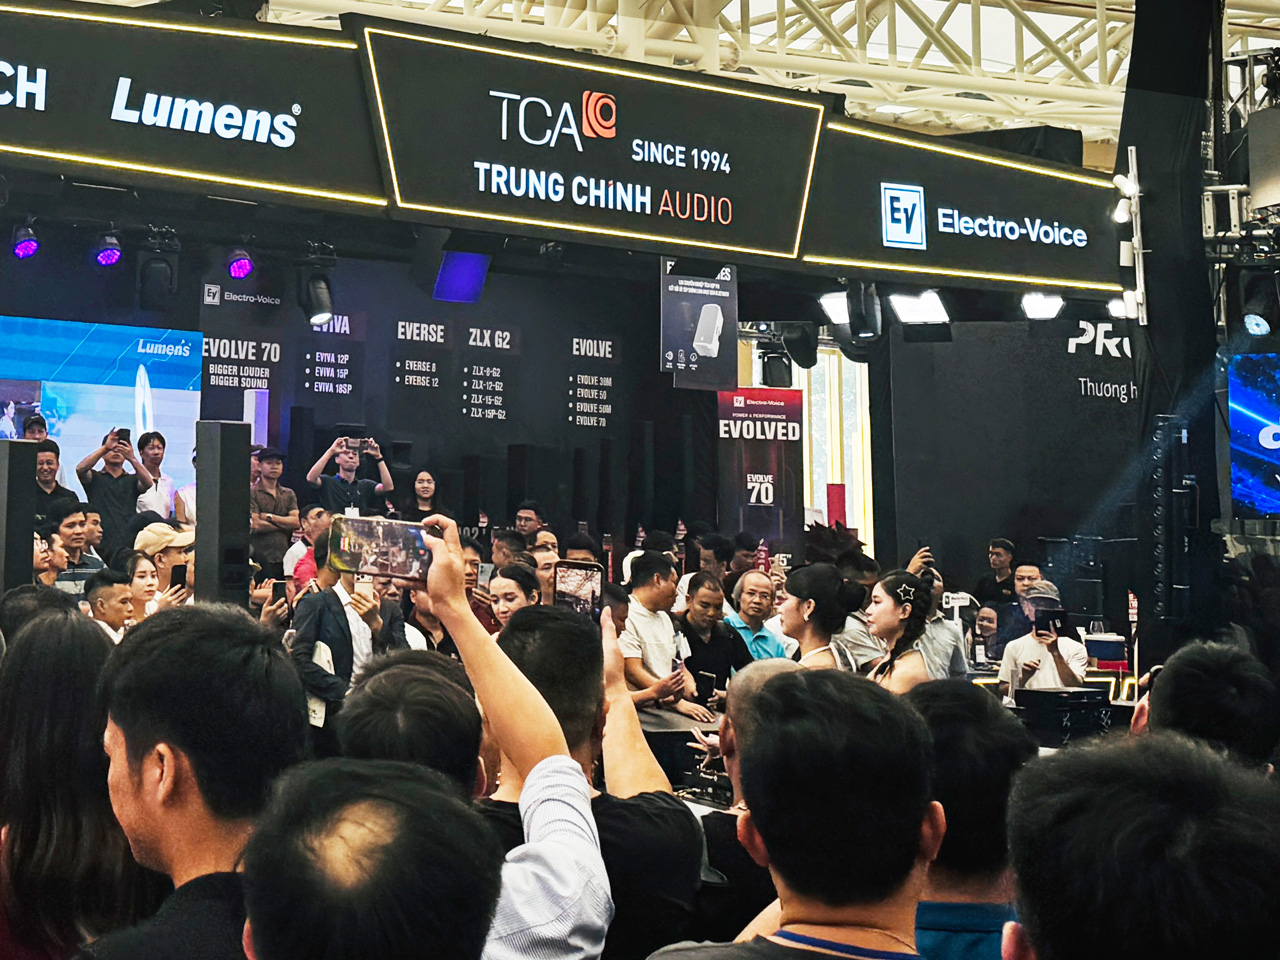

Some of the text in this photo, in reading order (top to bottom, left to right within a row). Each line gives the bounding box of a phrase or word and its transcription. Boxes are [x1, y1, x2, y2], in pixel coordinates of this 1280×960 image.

[489, 90, 584, 152] TCA
[631, 138, 732, 174] SINCE 1994
[473, 161, 565, 202] TRUNG
[658, 189, 733, 225] AUDIO
[937, 207, 1088, 248] Electro-Voice
[224, 291, 281, 305] Electro-Voice
[397, 321, 445, 343] EVERSE
[469, 328, 511, 349] ZLX G2
[138, 339, 191, 357] Lumens
[202, 338, 280, 362] EVOLVE 70
[572, 338, 613, 358] EVOLVE
[315, 352, 349, 364] EVIVA 12P
[209, 364, 270, 378] BIGGER LOUDER
[315, 366, 348, 379] EVIVA 15P
[405, 360, 431, 372] EVERSE
[210, 375, 268, 389] BIGGER SOUND
[314, 381, 334, 393] EVIVA
[404, 375, 439, 387] EVERSE 12
[472, 379, 504, 391] ZLX-12-G2
[577, 375, 599, 386] EVOLVE
[577, 388, 598, 399] EVOLVE
[1078, 377, 1128, 403] Thương
[471, 394, 503, 406] ZLX-15-G2
[576, 402, 598, 413] EVOLVE
[576, 416, 597, 426] EVOLVE
[719, 419, 800, 441] EVOLVED
[747, 474, 773, 483] EVOLVE
[747, 482, 774, 504] 70
